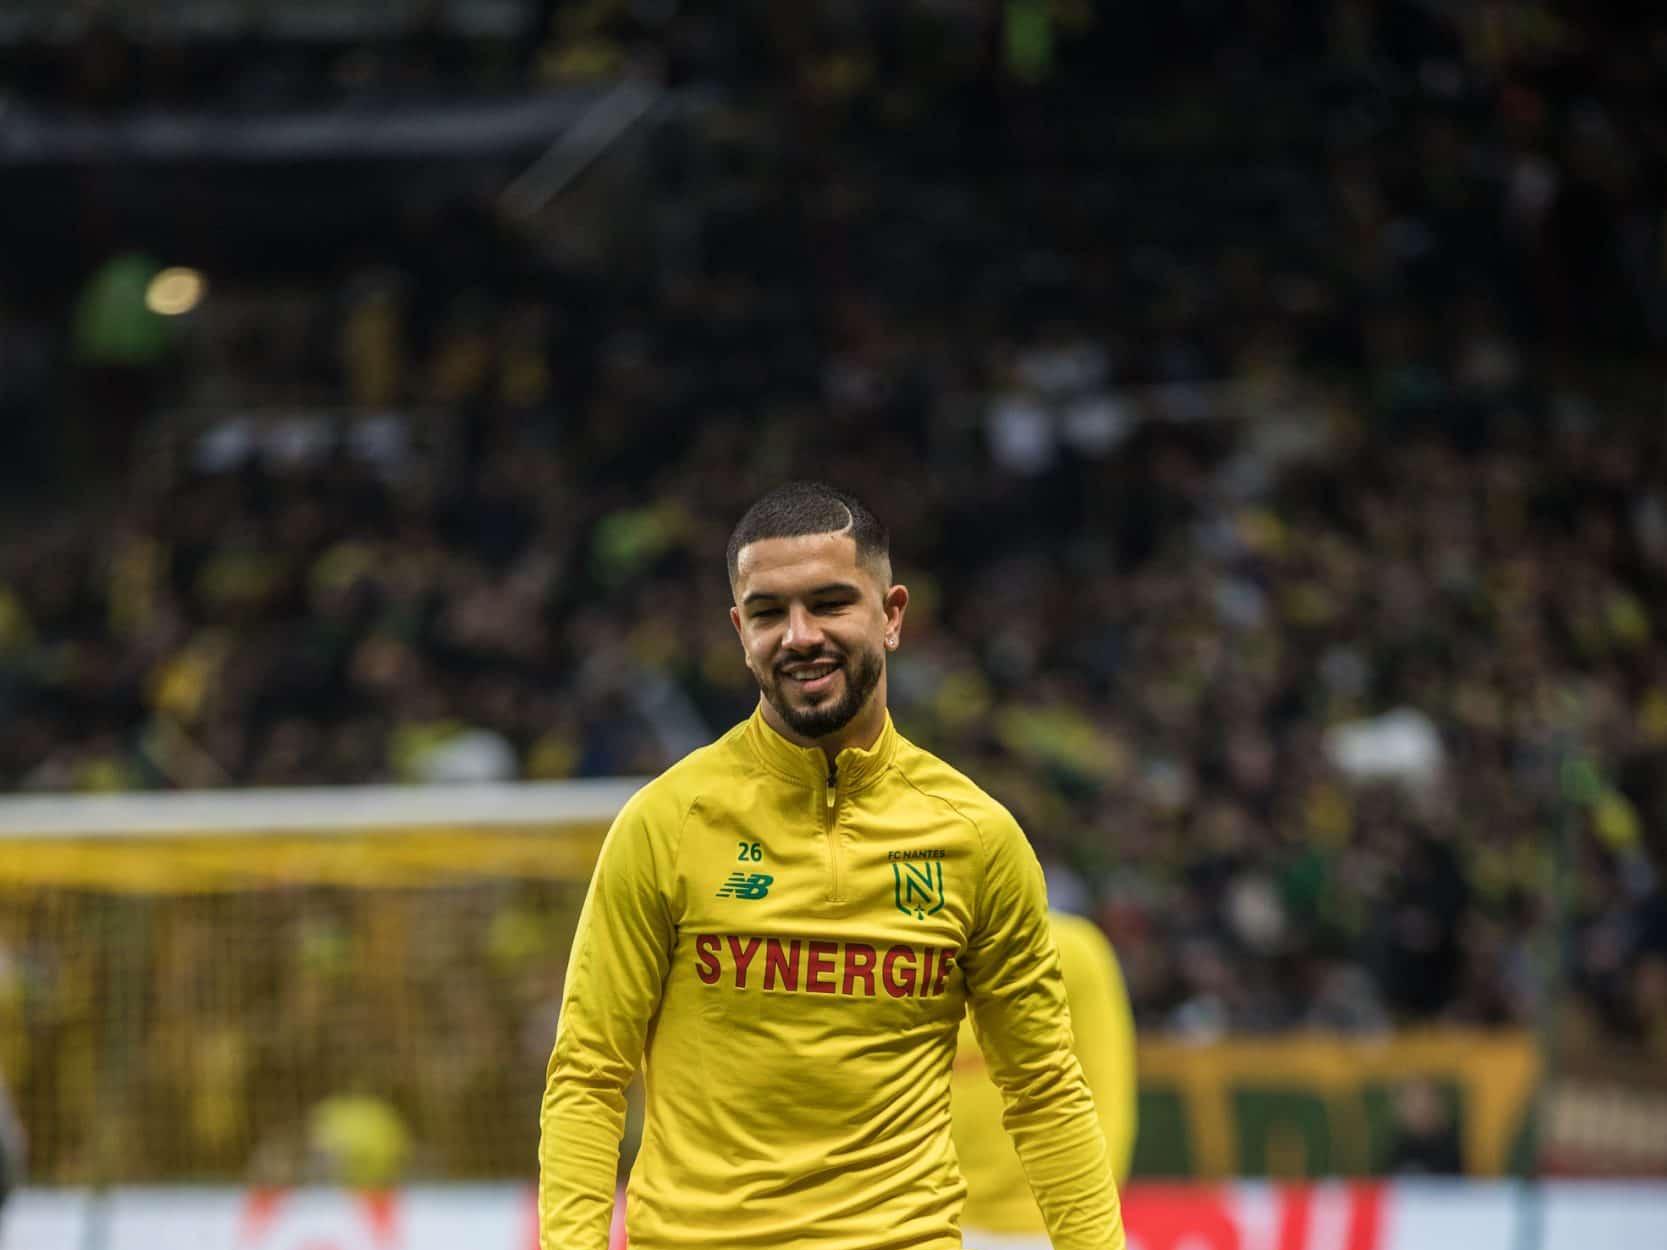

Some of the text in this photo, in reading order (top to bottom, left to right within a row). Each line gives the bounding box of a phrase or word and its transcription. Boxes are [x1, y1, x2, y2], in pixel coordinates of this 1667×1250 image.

[738, 842, 762, 862] 26
[888, 849, 945, 860] FC NANTES
